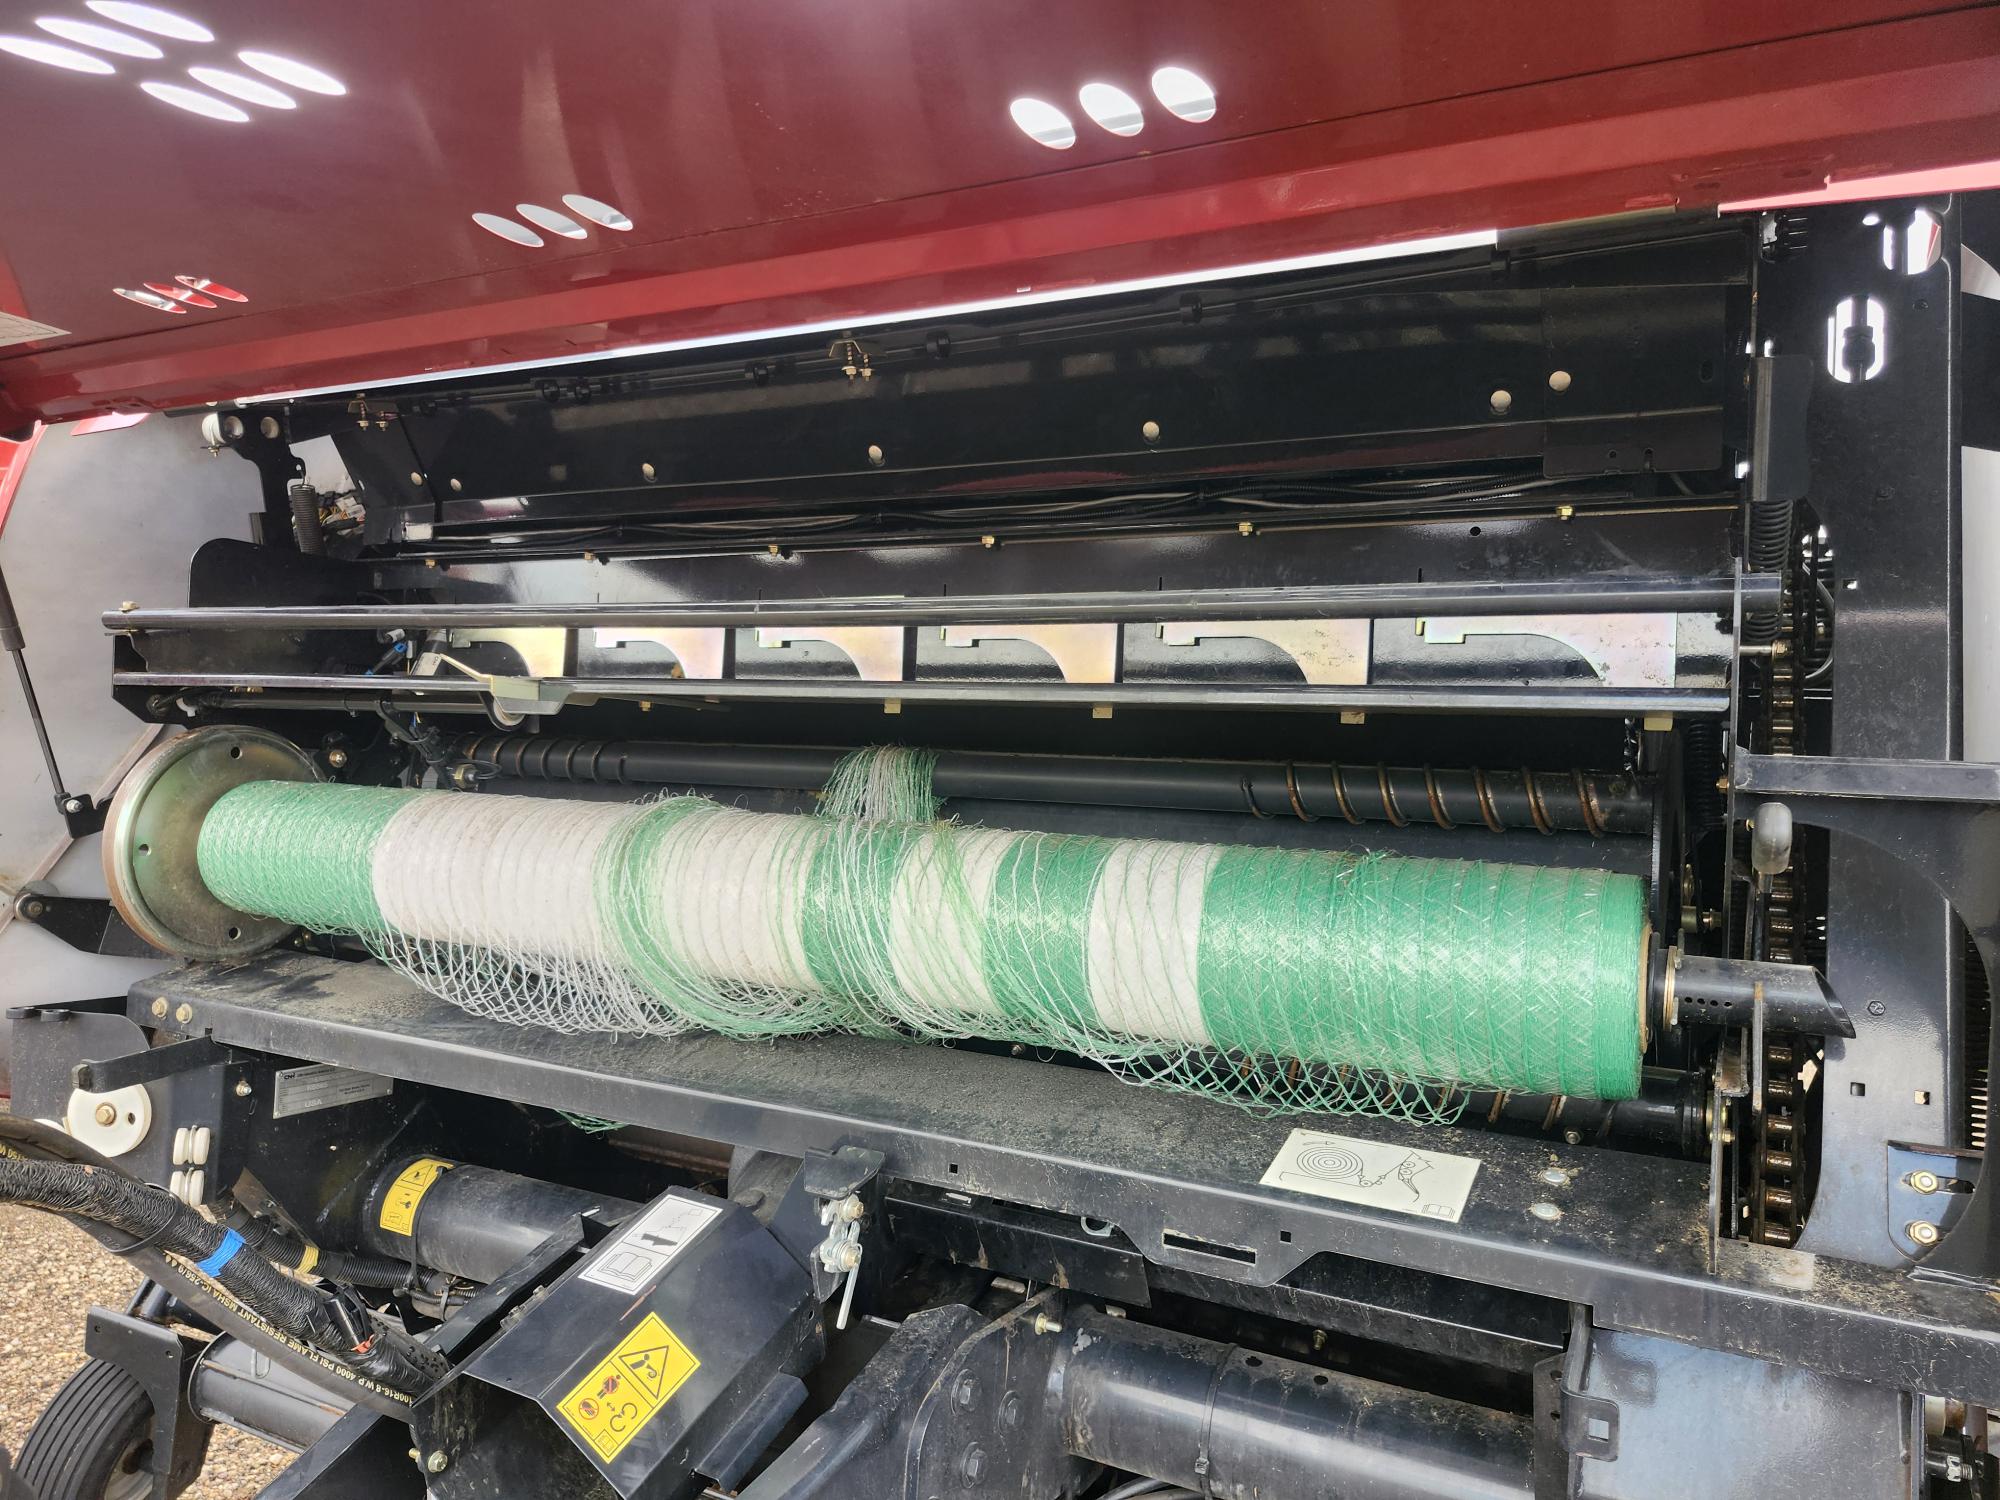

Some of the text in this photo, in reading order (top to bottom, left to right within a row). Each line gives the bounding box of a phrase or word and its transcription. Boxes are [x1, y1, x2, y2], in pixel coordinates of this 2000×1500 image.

[304, 1098, 323, 1108] USA
[212, 1288, 238, 1312] MSHA
[238, 1309, 288, 1345] RESISTANT
[287, 1338, 319, 1362] FLAME
[319, 1356, 335, 1371] PSI
[336, 1366, 356, 1381] 4000
